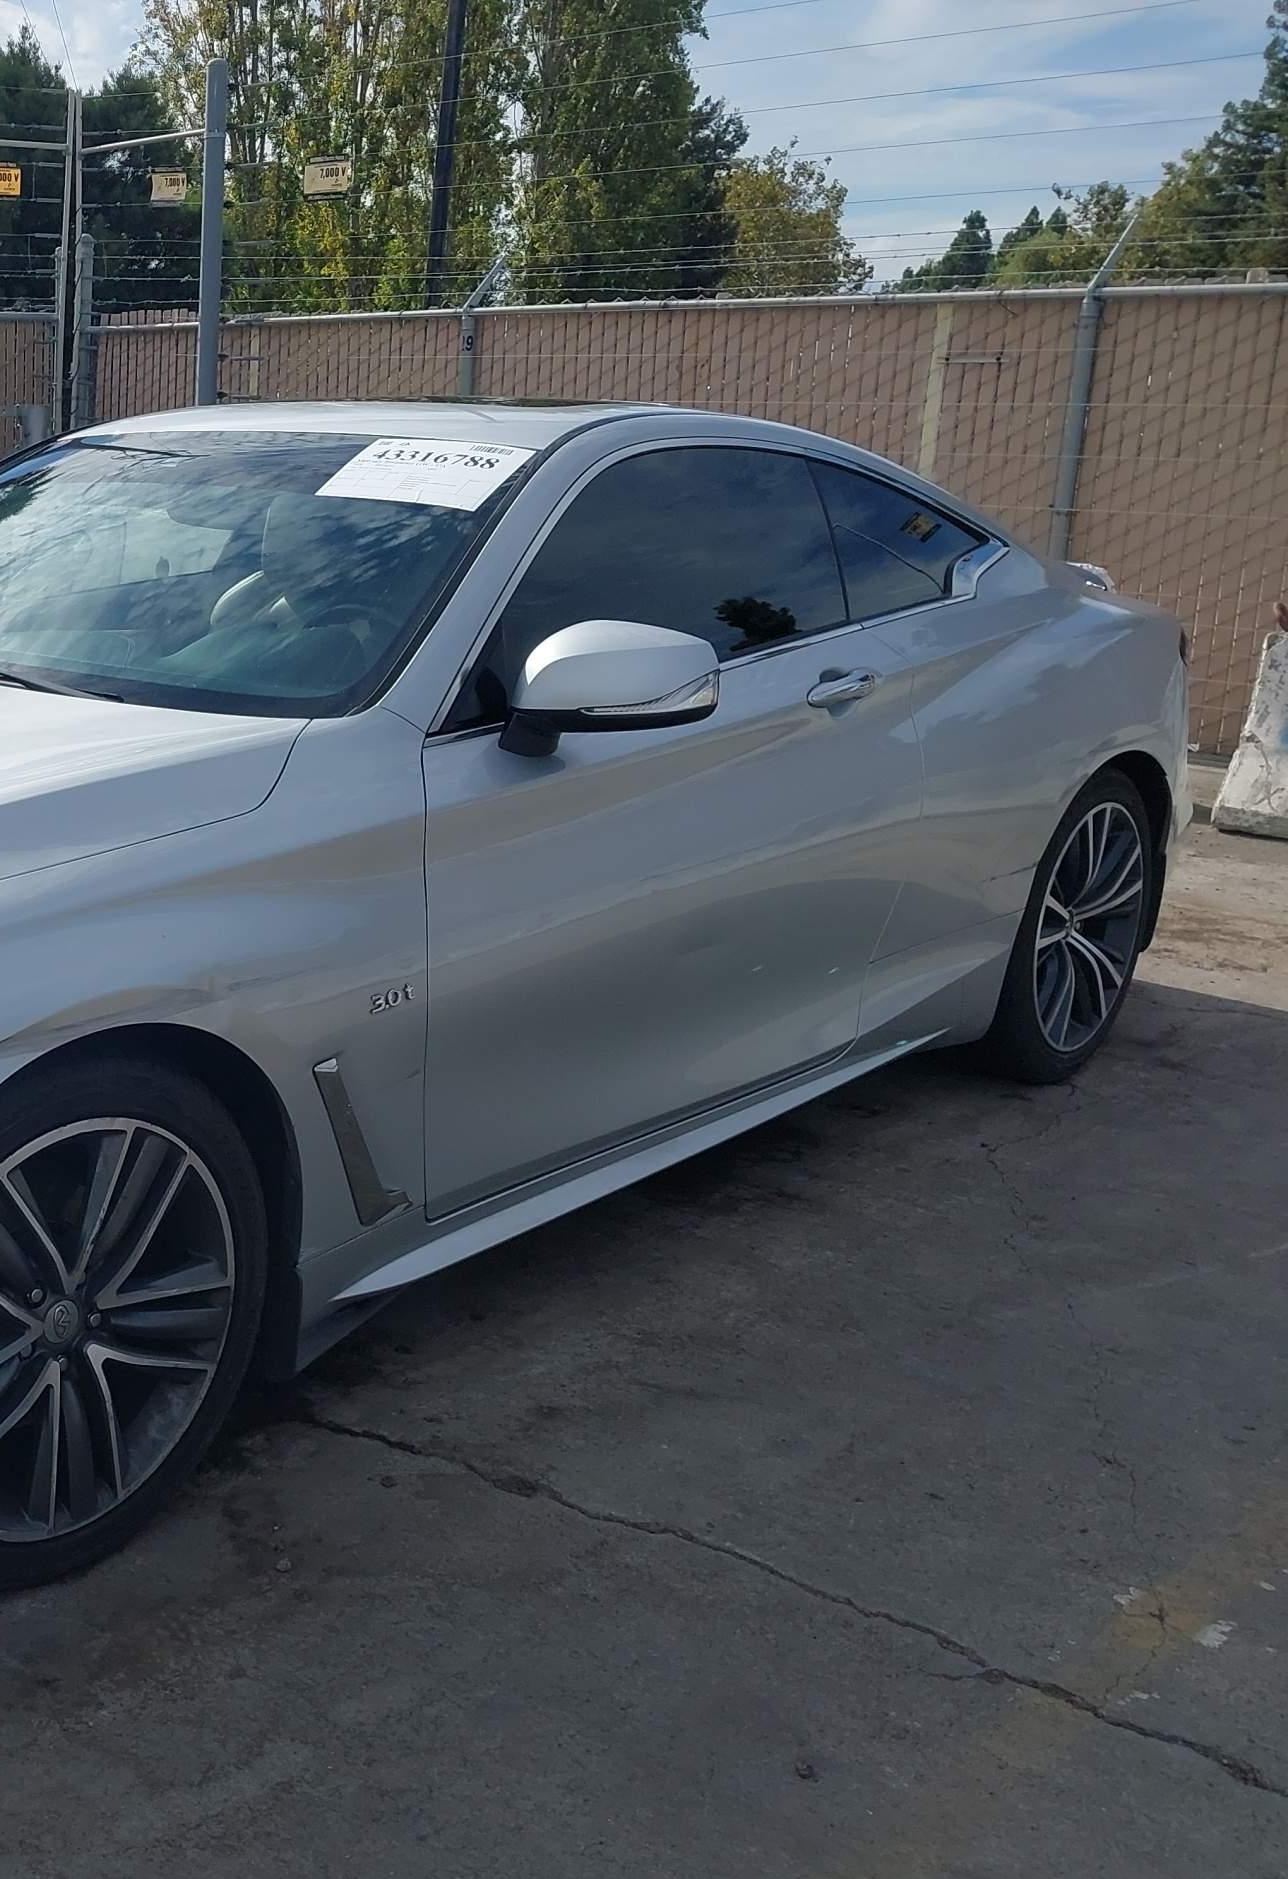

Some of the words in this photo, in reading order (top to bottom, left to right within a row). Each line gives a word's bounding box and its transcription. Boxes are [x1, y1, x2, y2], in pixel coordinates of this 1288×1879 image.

[14, 172, 19, 183] V
[319, 167, 340, 180] 7,000
[341, 166, 347, 177] V
[373, 449, 500, 470] 43316788
[369, 983, 416, 1015] 3.0t
